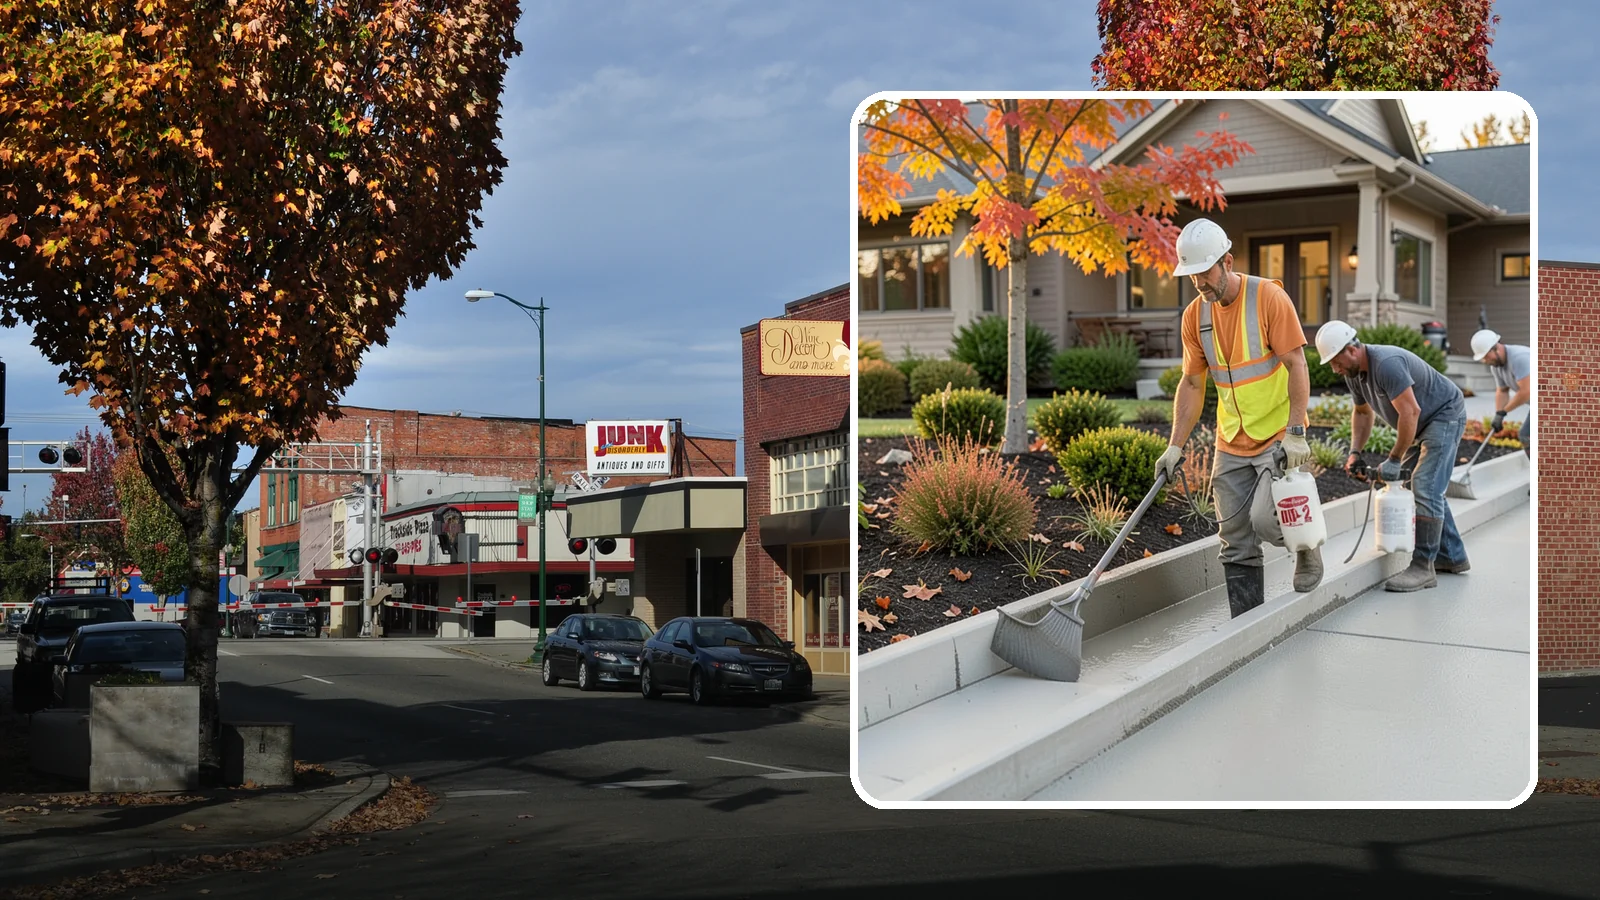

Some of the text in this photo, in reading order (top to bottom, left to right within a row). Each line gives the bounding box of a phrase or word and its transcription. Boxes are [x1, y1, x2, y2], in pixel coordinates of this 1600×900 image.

[596, 425, 664, 457] JUNK
[607, 446, 646, 454] DISORDERLY
[597, 460, 666, 470] ANTIQUES AND GIFTS
[573, 473, 589, 492] RAIL
[352, 498, 365, 511] CRO
[414, 519, 429, 535] Pizza
